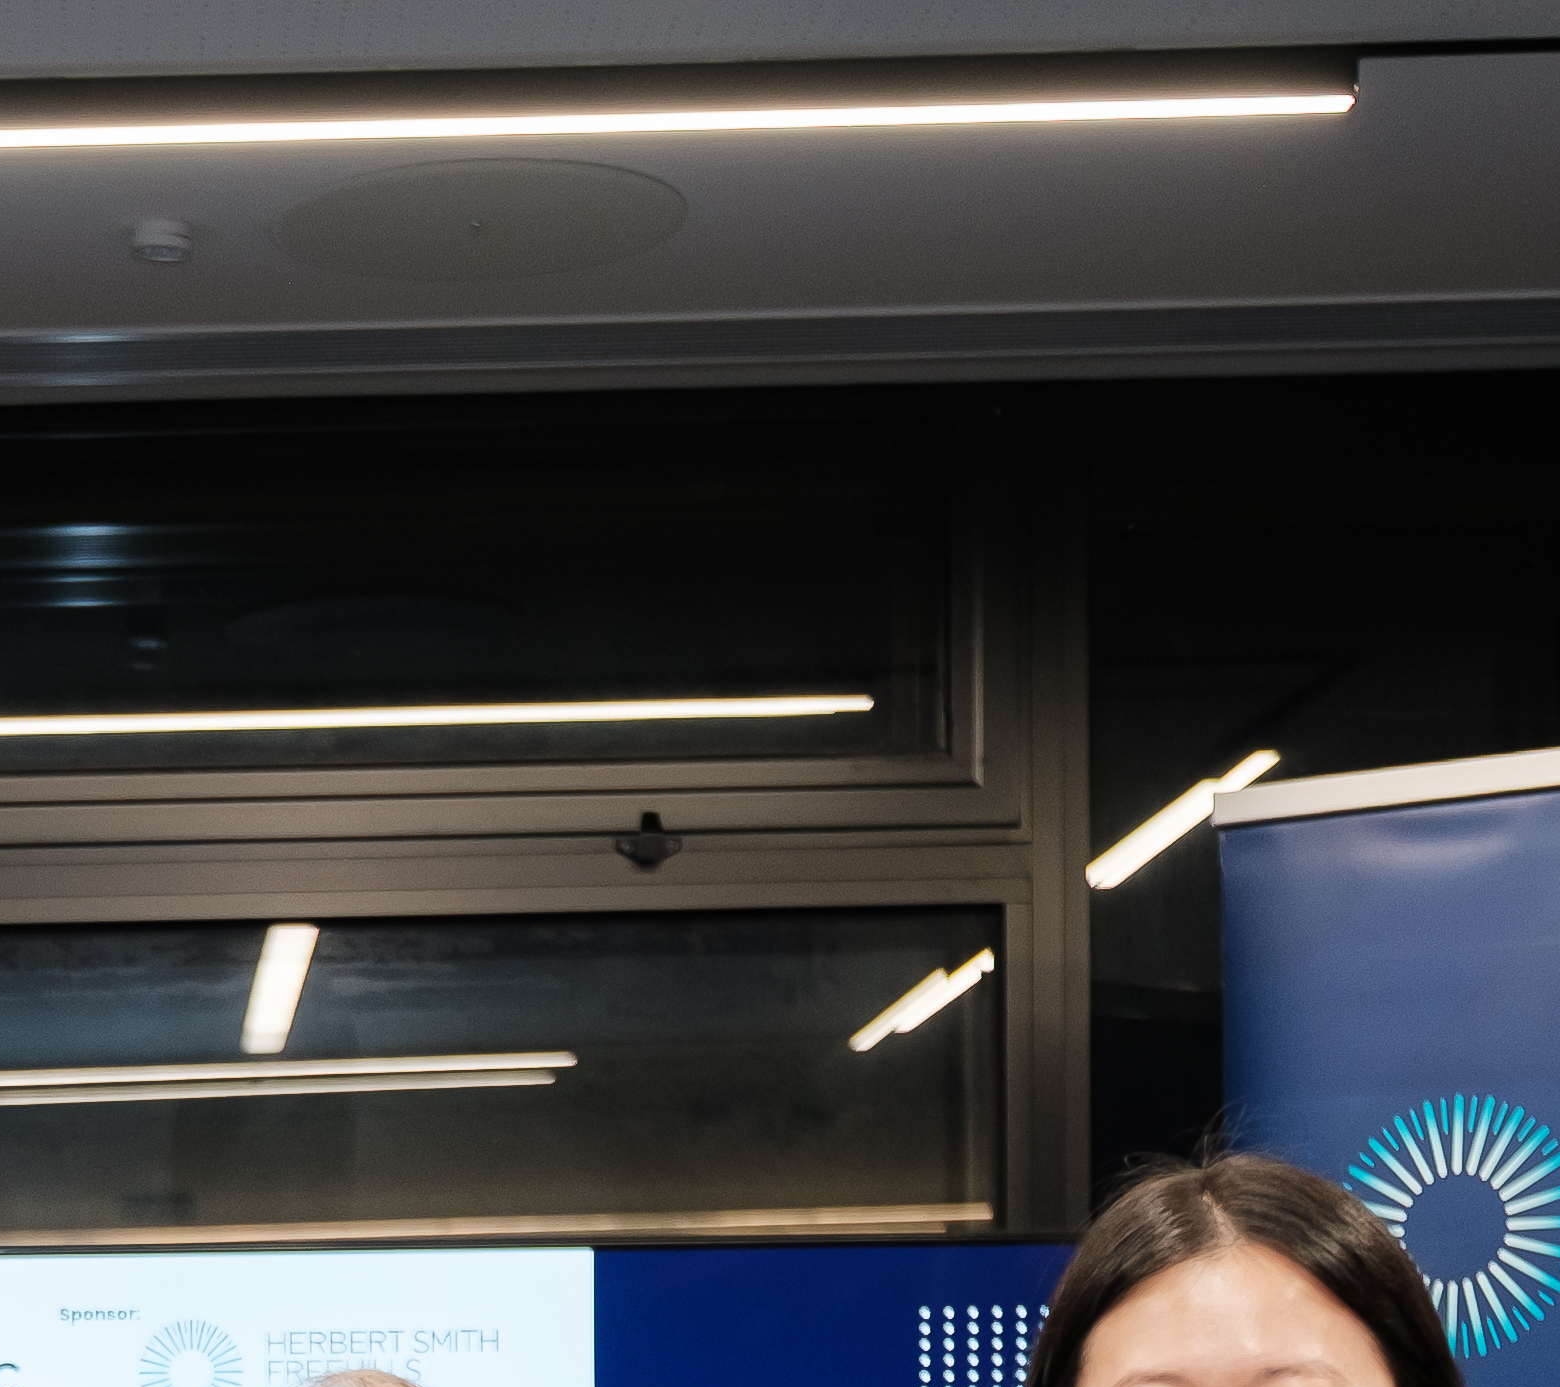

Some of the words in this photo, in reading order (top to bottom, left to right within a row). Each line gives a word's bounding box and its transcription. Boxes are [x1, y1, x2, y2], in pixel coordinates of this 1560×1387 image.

[59, 1307, 141, 1326] Sponsor:
[266, 1330, 406, 1355] HERBERT
[413, 1328, 501, 1354] SMITH
